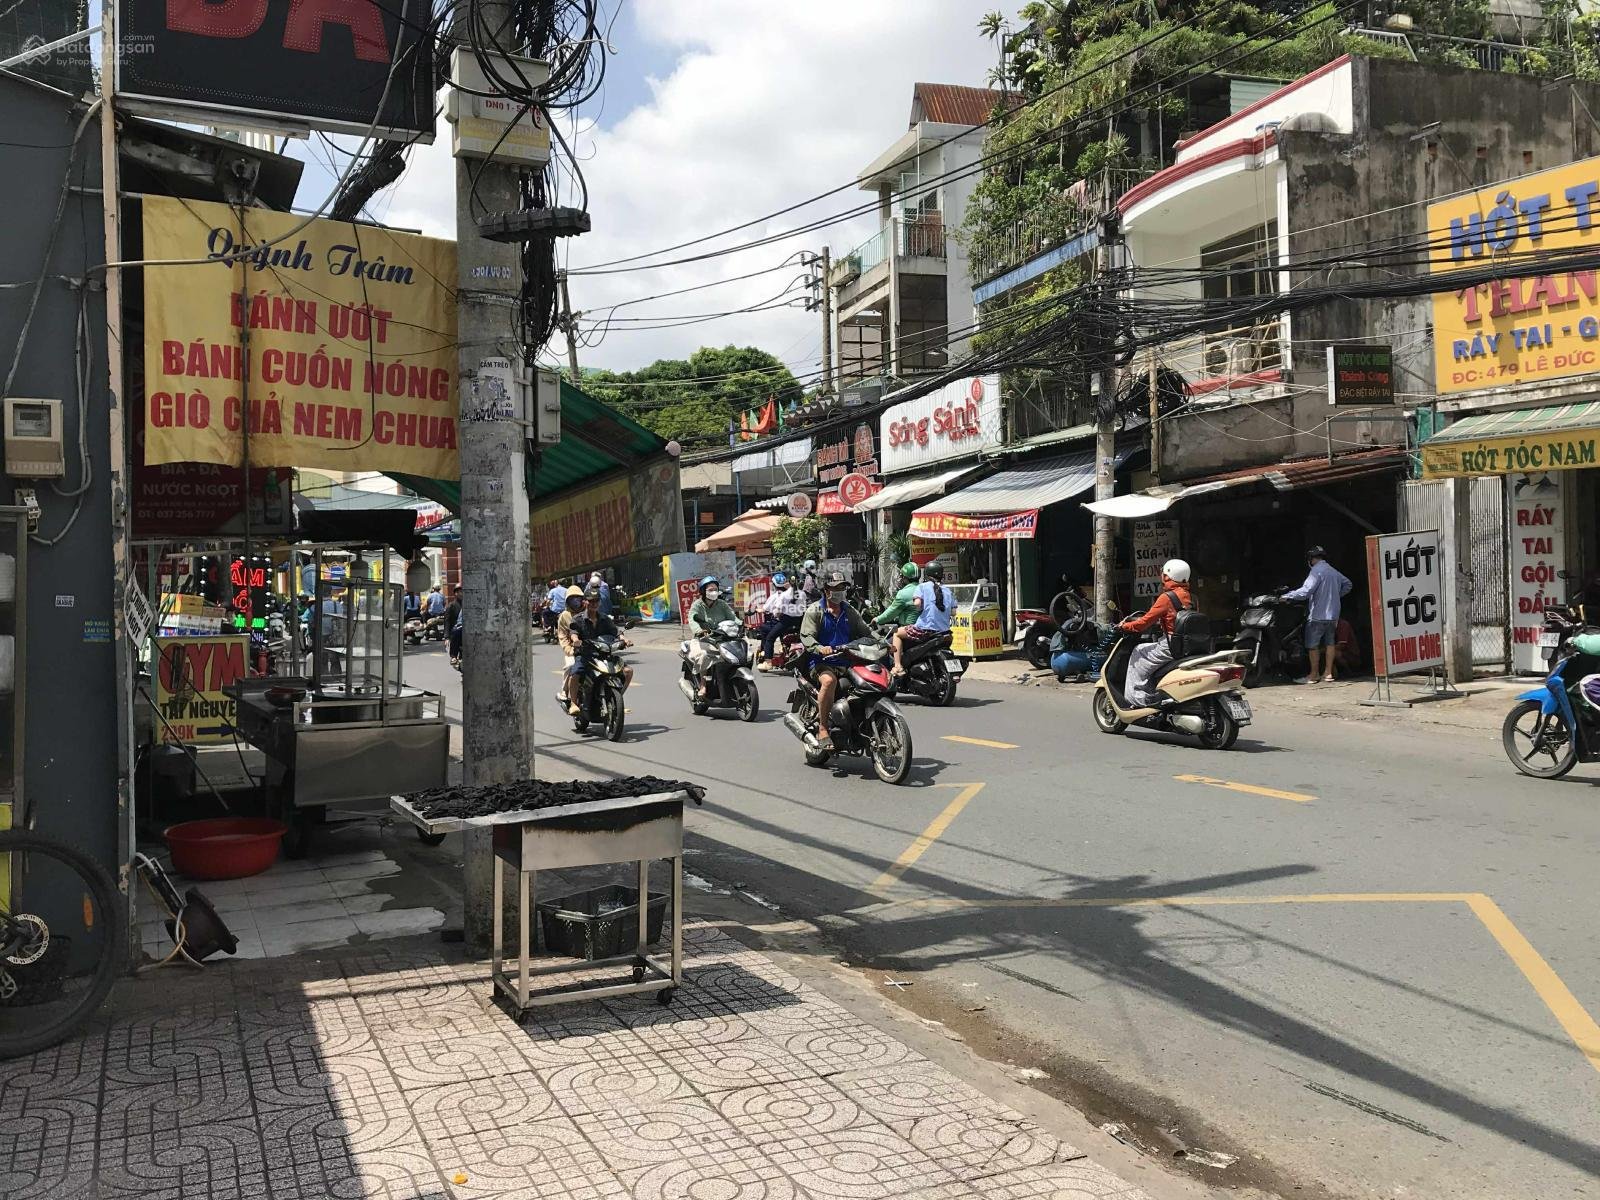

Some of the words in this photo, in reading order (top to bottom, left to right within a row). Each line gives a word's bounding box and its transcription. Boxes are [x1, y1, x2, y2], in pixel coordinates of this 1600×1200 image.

[1450, 190, 1551, 266] HỚT
[207, 227, 314, 272] Quỳnh
[327, 243, 417, 285] Trâm
[230, 290, 317, 335] BÁNH
[329, 301, 393, 344] ƯỚT
[1453, 329, 1503, 361] RÁY
[1509, 323, 1553, 351] TAI
[1579, 315, 1600, 338] G
[162, 337, 251, 382] BÁNH
[261, 343, 353, 392] CUỐN
[363, 359, 450, 402] NÓNG
[1525, 355, 1549, 373] LÊ
[1553, 350, 1596, 369] ĐỨC
[150, 388, 211, 429] GIÒ
[223, 391, 283, 434] CHẢ
[293, 401, 363, 441] NEM
[373, 410, 457, 450] CHUA
[1461, 443, 1499, 472] HỚT
[1504, 440, 1543, 470] TÓC
[1548, 439, 1596, 466] NAM
[143, 482, 192, 496] NƯỚC
[195, 484, 239, 498] NGỌT
[1517, 504, 1556, 526] RÁY
[1385, 537, 1436, 580] HỚT
[1522, 537, 1553, 555] TAI
[1138, 564, 1161, 578] HON
[1521, 560, 1556, 588] GỘI
[1387, 585, 1436, 627] TÓC
[1389, 634, 1418, 665] THÀNH
[1418, 630, 1441, 661] CÔNG
[159, 643, 246, 694] GYM
[189, 700, 237, 720] NGUYE
